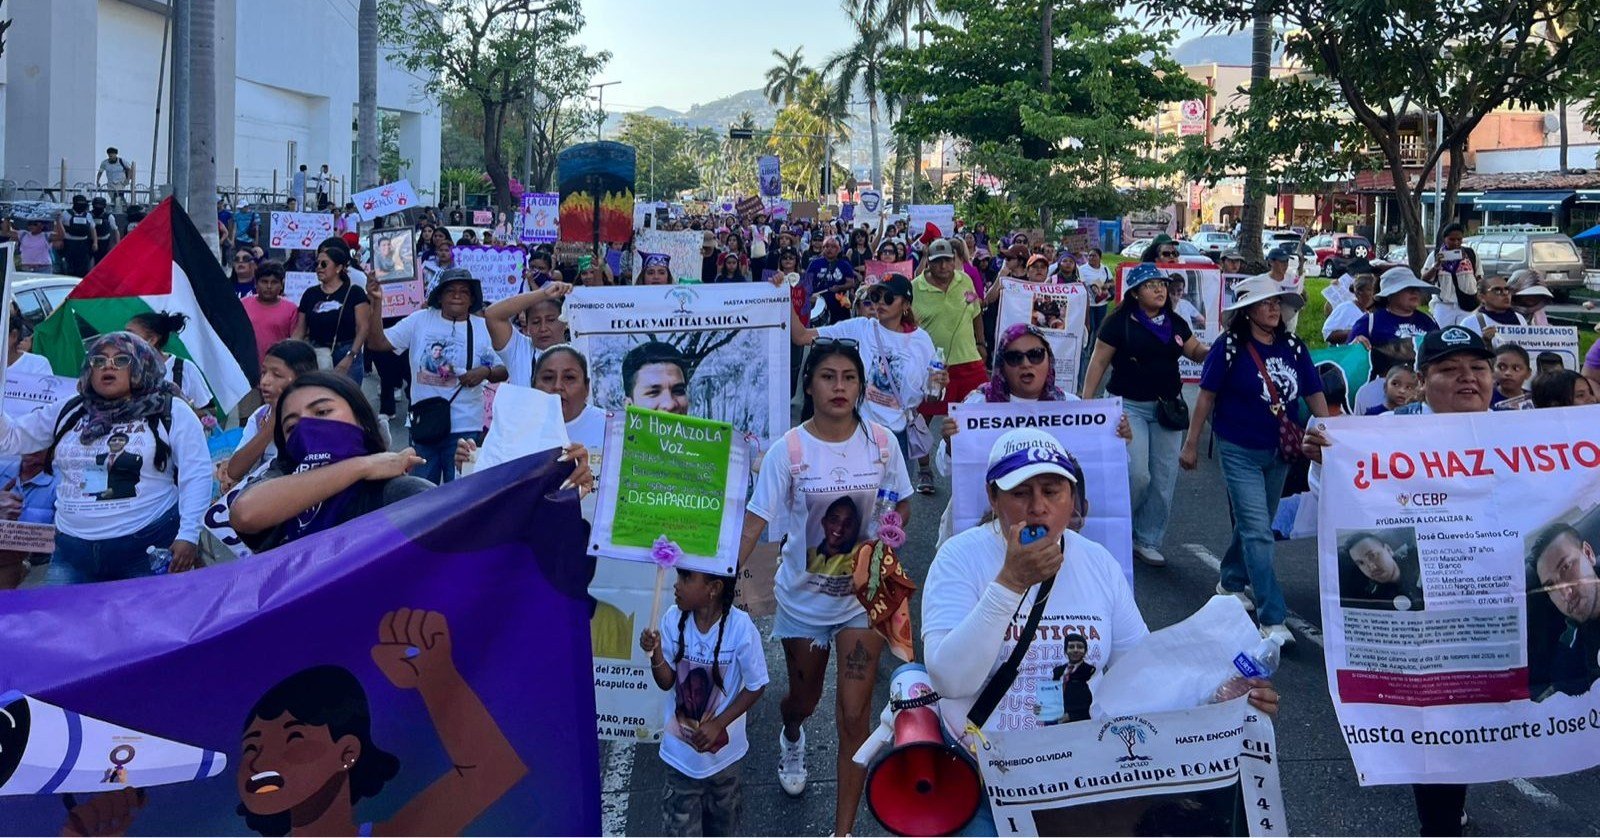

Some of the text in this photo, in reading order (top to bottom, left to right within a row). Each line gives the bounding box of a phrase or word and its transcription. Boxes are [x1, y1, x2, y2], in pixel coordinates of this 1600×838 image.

[1040, 284, 1078, 294] BUSCA
[744, 296, 790, 304] ENCONTRABLES
[611, 318, 648, 328] EDGAR
[652, 318, 677, 327] YAIR
[679, 316, 702, 326] LEAL
[968, 413, 1106, 430] DESAPARECIDO
[1003, 438, 1058, 453] Jhonatan
[1353, 440, 1600, 490] ¿LO HAZ VISTO
[628, 490, 720, 510] DESAPARECIDO
[1412, 493, 1448, 506] CEBP
[1418, 529, 1519, 540] José Quevedo Santos Coy
[596, 665, 610, 674] del
[595, 680, 648, 690] Acapulco de
[623, 716, 645, 726] PERO
[606, 728, 613, 736] A
[614, 728, 636, 738] UNIR
[1344, 725, 1404, 744] Hasta
[1411, 722, 1541, 745] encontrarte
[1546, 715, 1586, 736] Jose
[1175, 735, 1205, 744] HASTA
[989, 751, 1072, 768] PROHIBIDO OLVIDAR
[988, 782, 1069, 798] Jhonatan
[1074, 765, 1176, 788] Guadalupe
